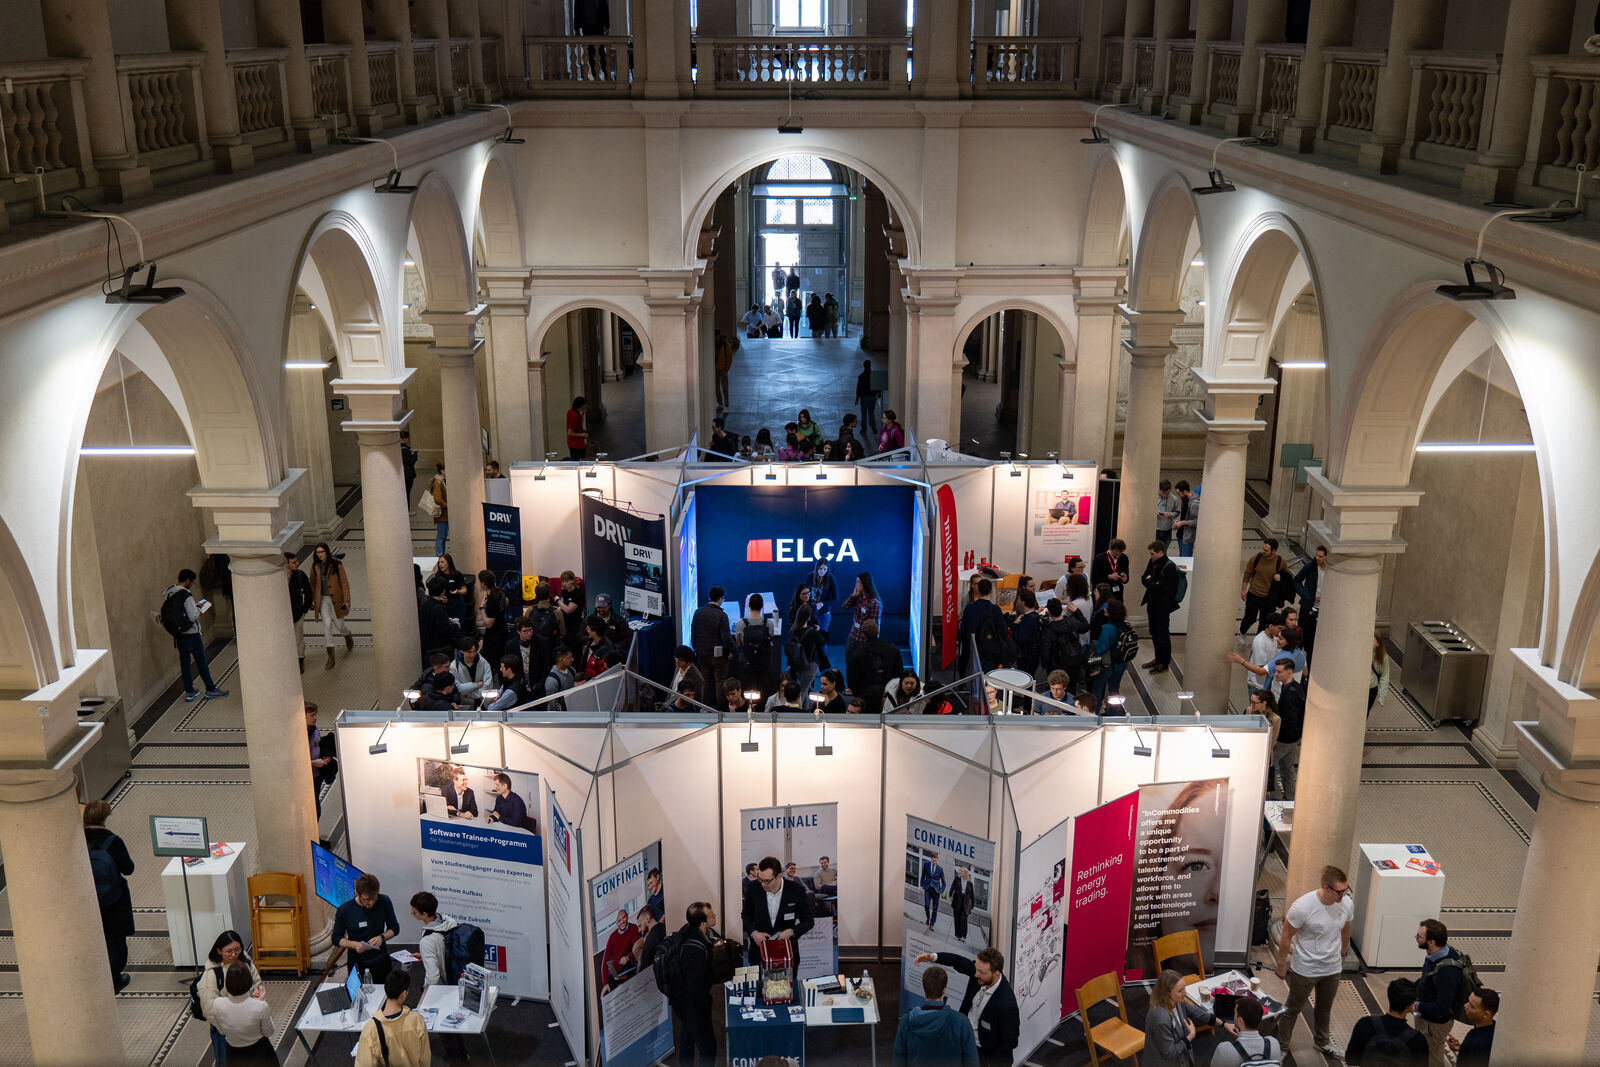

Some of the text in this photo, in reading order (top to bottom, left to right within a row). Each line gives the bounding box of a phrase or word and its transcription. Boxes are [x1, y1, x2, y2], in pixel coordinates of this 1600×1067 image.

[490, 512, 512, 524] DRW
[594, 514, 632, 547] DRW
[632, 548, 652, 560] DRW
[776, 538, 860, 562] ELCA
[750, 814, 818, 831] CONFINALE
[429, 828, 528, 848] Software Trainee-Programm
[1146, 828, 1172, 836] unique
[914, 828, 976, 858] CONFINALE
[1140, 836, 1183, 846] opportunity
[1164, 846, 1180, 854] part
[1149, 855, 1186, 863] extremely
[445, 860, 492, 872] Studienabgänger
[506, 869, 533, 878] Experten
[1077, 854, 1123, 882] Rethinking
[596, 858, 648, 898] CONFINALE
[1137, 874, 1176, 883] workforce,
[432, 885, 461, 894] Know-how
[1076, 874, 1107, 895] energy
[1076, 888, 1108, 908] trading.
[1150, 900, 1196, 910] technologies
[468, 916, 491, 924] Zukunft
[1151, 910, 1190, 920] passionate
